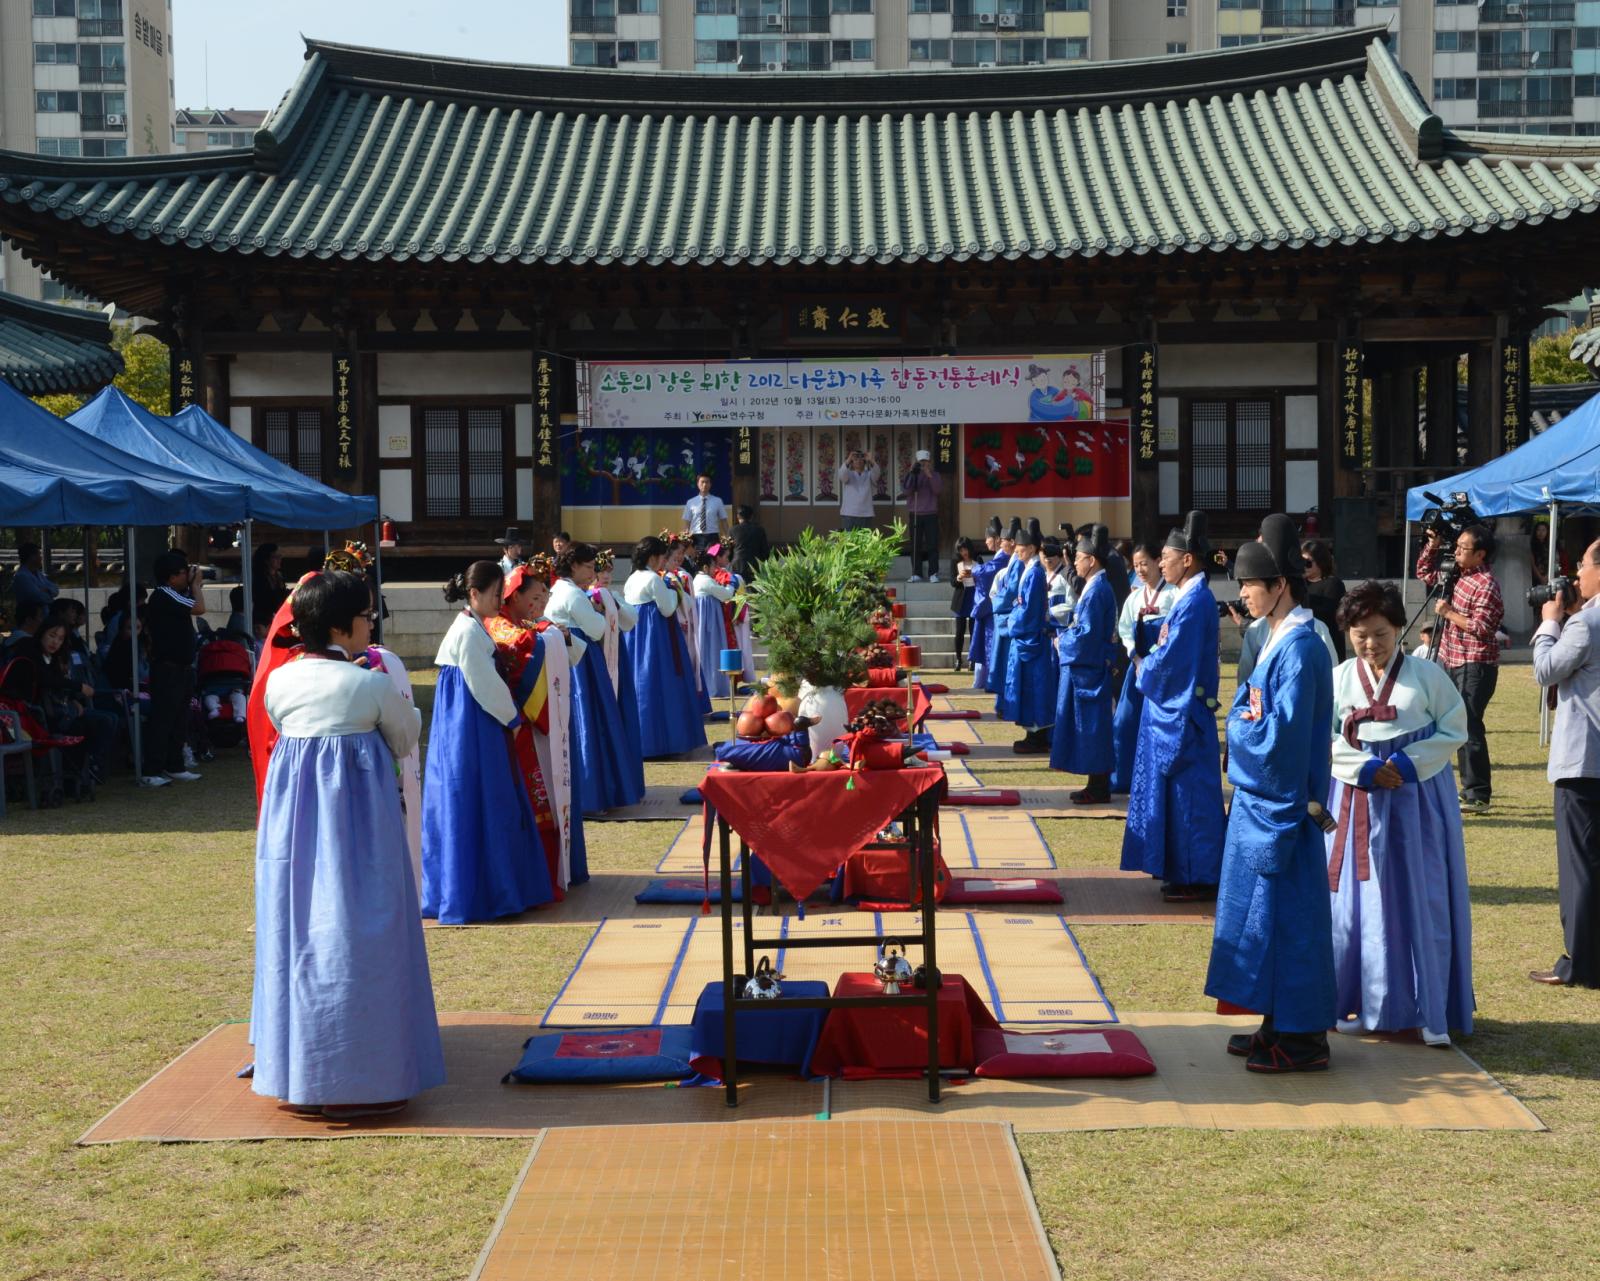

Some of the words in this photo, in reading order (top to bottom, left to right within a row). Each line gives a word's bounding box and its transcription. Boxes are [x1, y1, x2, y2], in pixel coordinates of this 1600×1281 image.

[601, 371, 651, 393] 소통의
[658, 371, 695, 393] 장을
[701, 370, 742, 392] 위한
[748, 373, 783, 388] 2012
[789, 368, 885, 391] 다문화가족
[890, 366, 1020, 390] 합동전통혼례식
[720, 398, 737, 407] 일시
[751, 397, 778, 406] 2012년
[784, 397, 802, 406] 10월
[807, 396, 840, 405] 13일(토)
[664, 411, 681, 420] 주최
[692, 410, 728, 422] Yeonsu
[729, 410, 765, 420] 연수구청
[796, 410, 813, 420] 주관
[840, 408, 946, 419] 연수구다문화가족지원센터
